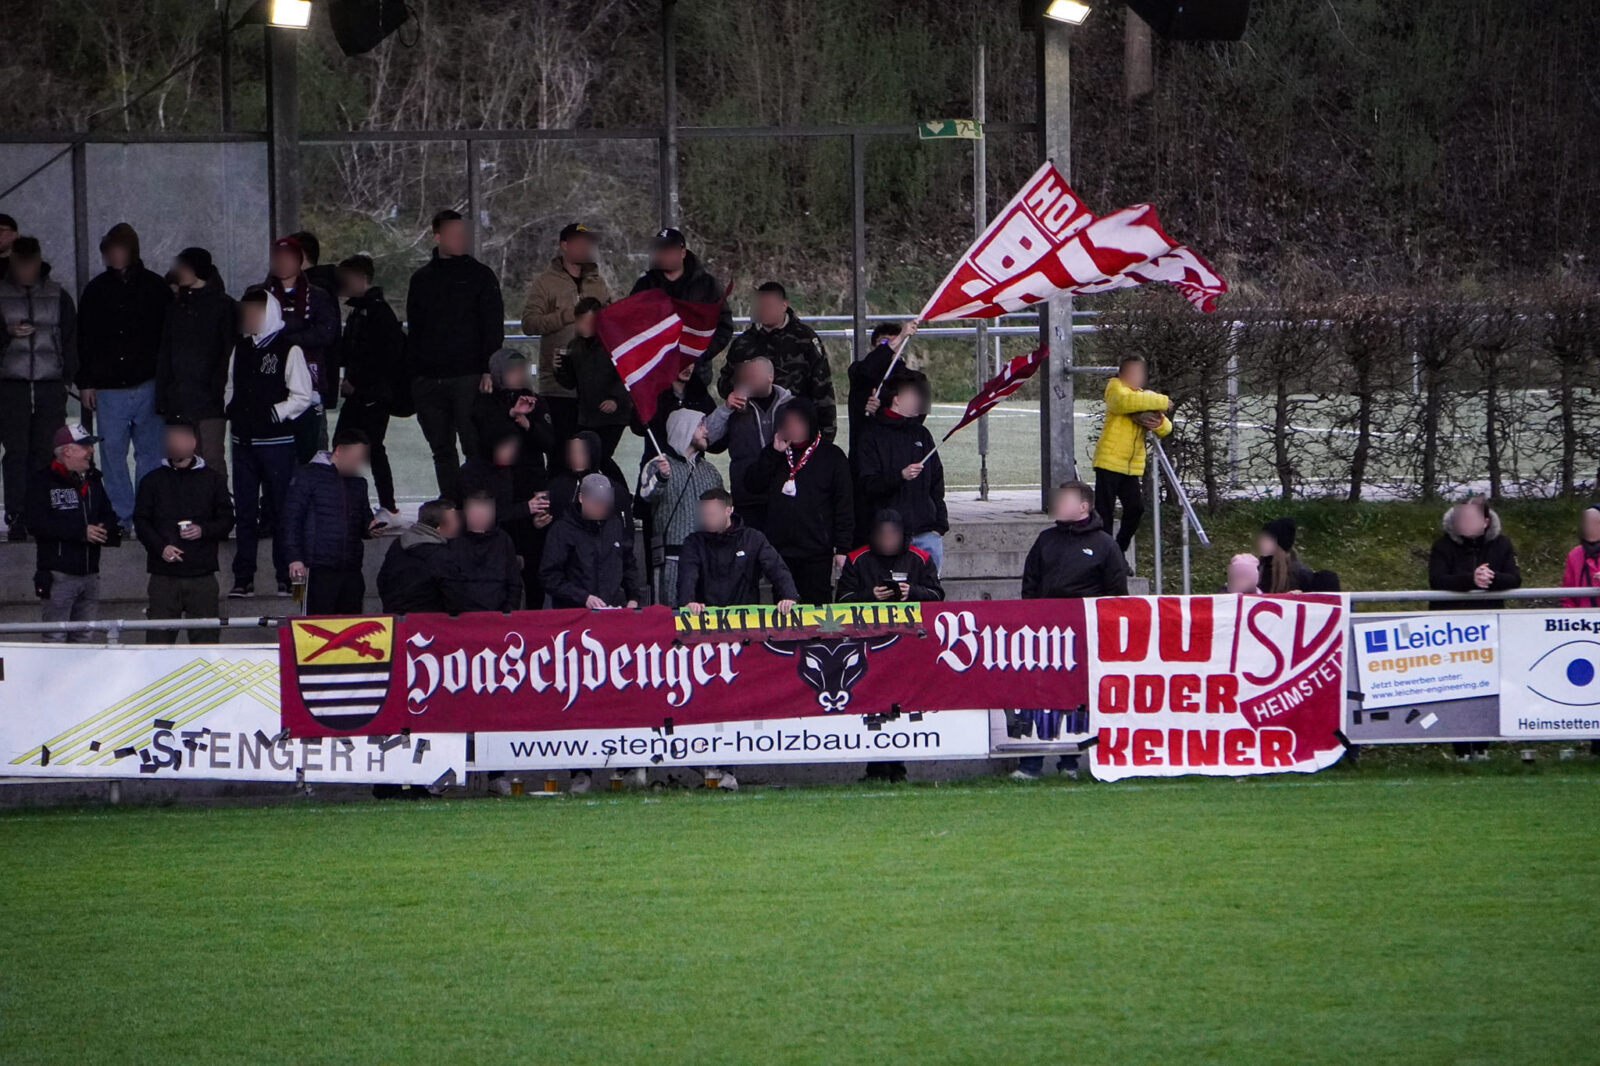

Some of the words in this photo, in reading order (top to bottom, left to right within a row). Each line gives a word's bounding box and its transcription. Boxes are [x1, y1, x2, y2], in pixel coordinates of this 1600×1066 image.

[679, 607, 804, 634] SEKTION
[850, 604, 915, 629] KIES
[1096, 596, 1213, 662] DU
[1394, 622, 1490, 650] Leicher
[934, 610, 1078, 672] Buam
[1242, 600, 1341, 686] SV
[1368, 648, 1494, 673] enginering
[1098, 674, 1238, 713] ODER
[1519, 718, 1600, 730] Heimstetten
[152, 729, 353, 771] STENGER
[511, 729, 941, 760] www.stenger-holzbau.com
[1097, 727, 1293, 767] KEINER
